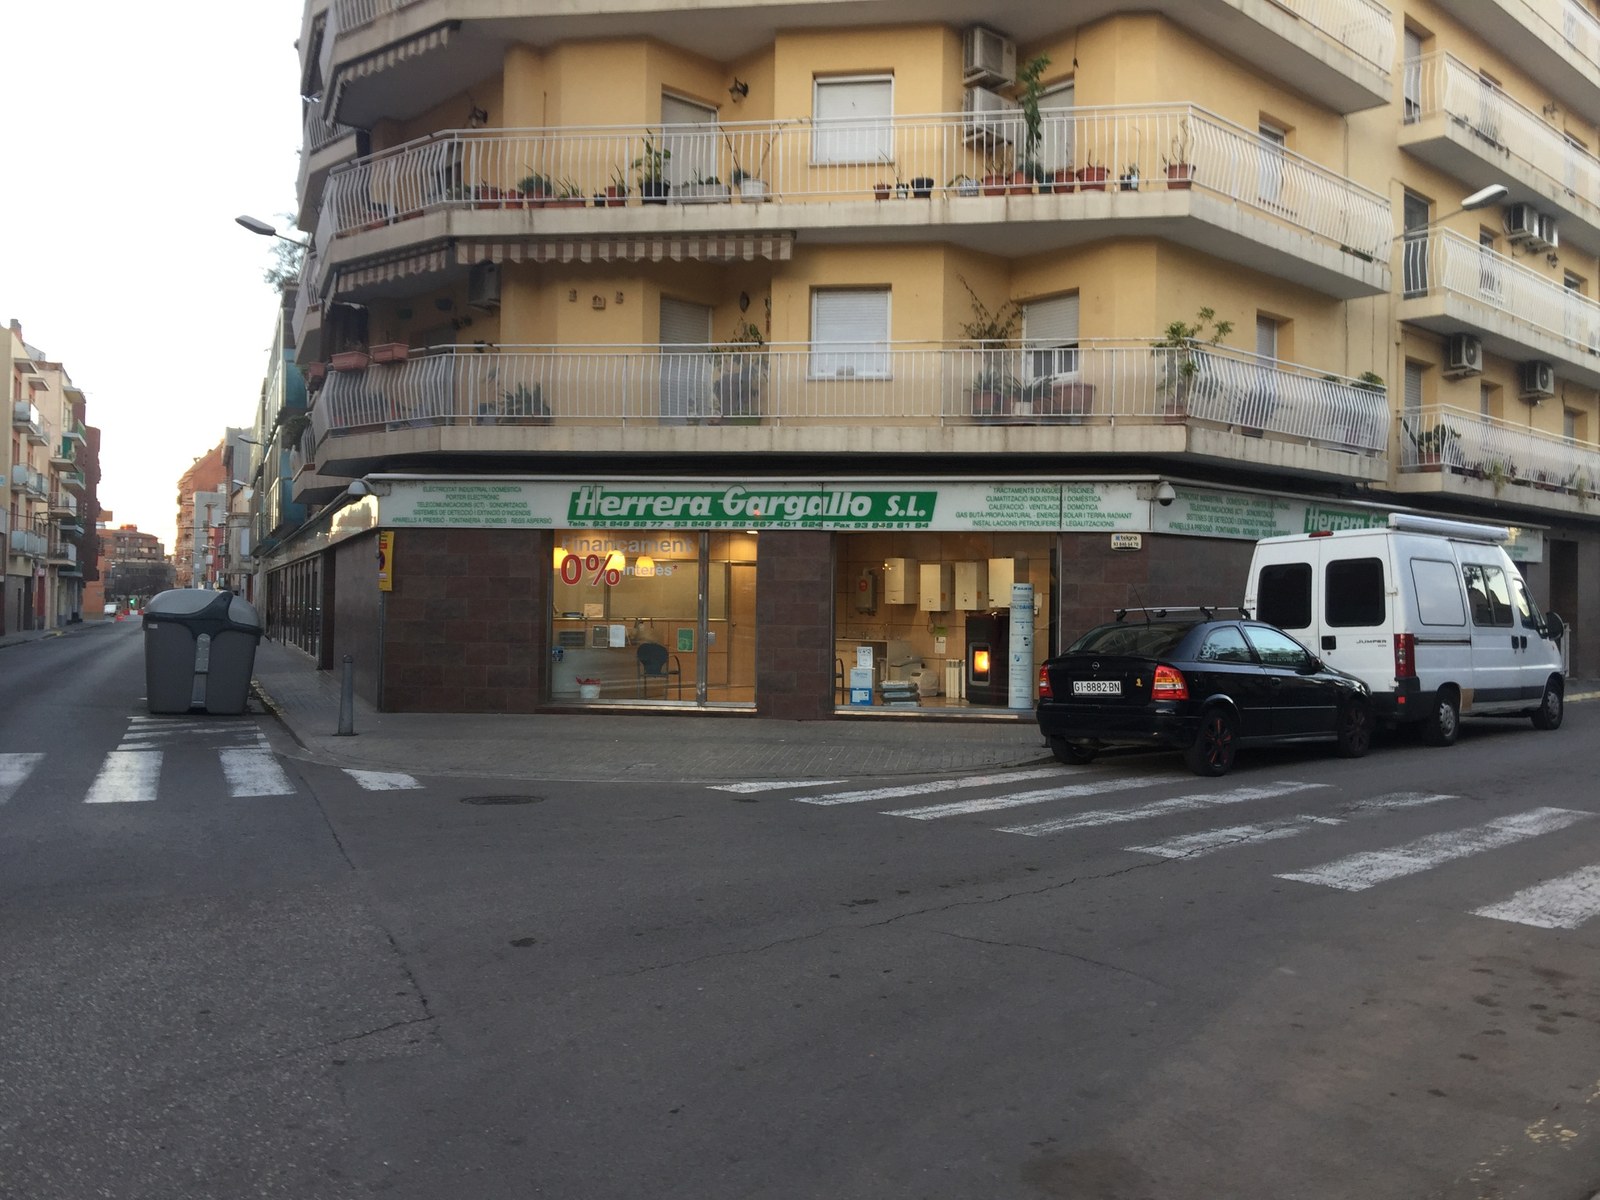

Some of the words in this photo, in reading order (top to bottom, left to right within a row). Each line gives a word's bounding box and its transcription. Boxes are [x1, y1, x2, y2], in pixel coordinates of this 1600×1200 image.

[575, 485, 712, 517] Herrera
[717, 484, 872, 521] Gargallo
[885, 495, 926, 517] S.L.
[560, 554, 620, 586] 0%
